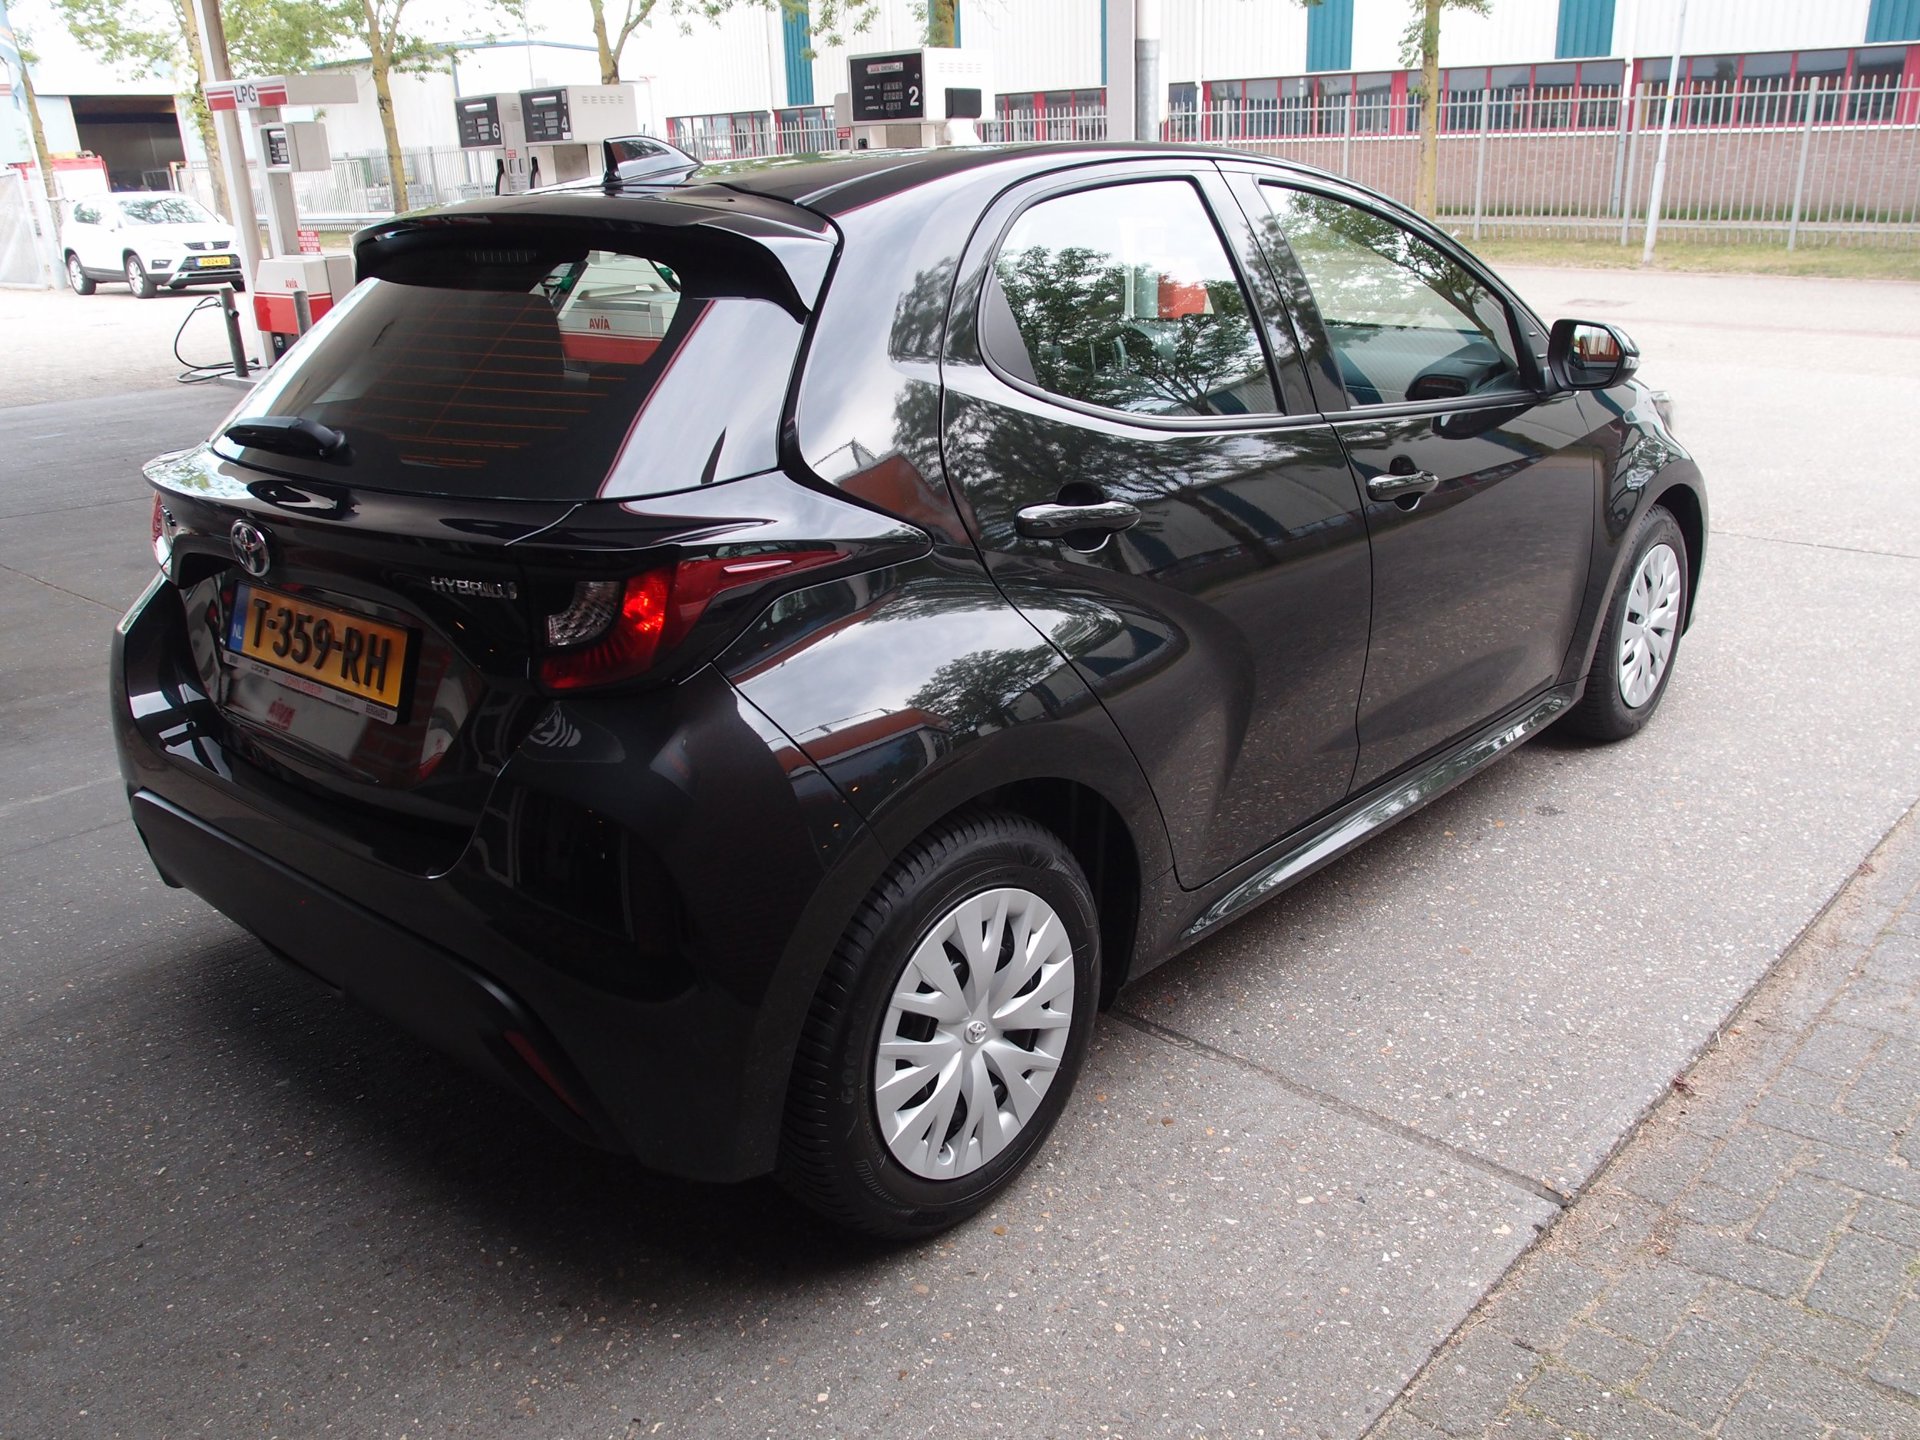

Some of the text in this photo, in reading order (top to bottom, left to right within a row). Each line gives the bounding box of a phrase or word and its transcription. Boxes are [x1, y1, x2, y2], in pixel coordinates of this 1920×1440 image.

[233, 84, 257, 103] LPG
[908, 86, 920, 106] 2
[491, 122, 500, 139] 6
[561, 116, 569, 131] 4
[285, 278, 299, 288] AVIA
[589, 316, 611, 330] AVIA
[232, 623, 243, 640] NL
[251, 597, 391, 694] T-359-RH
